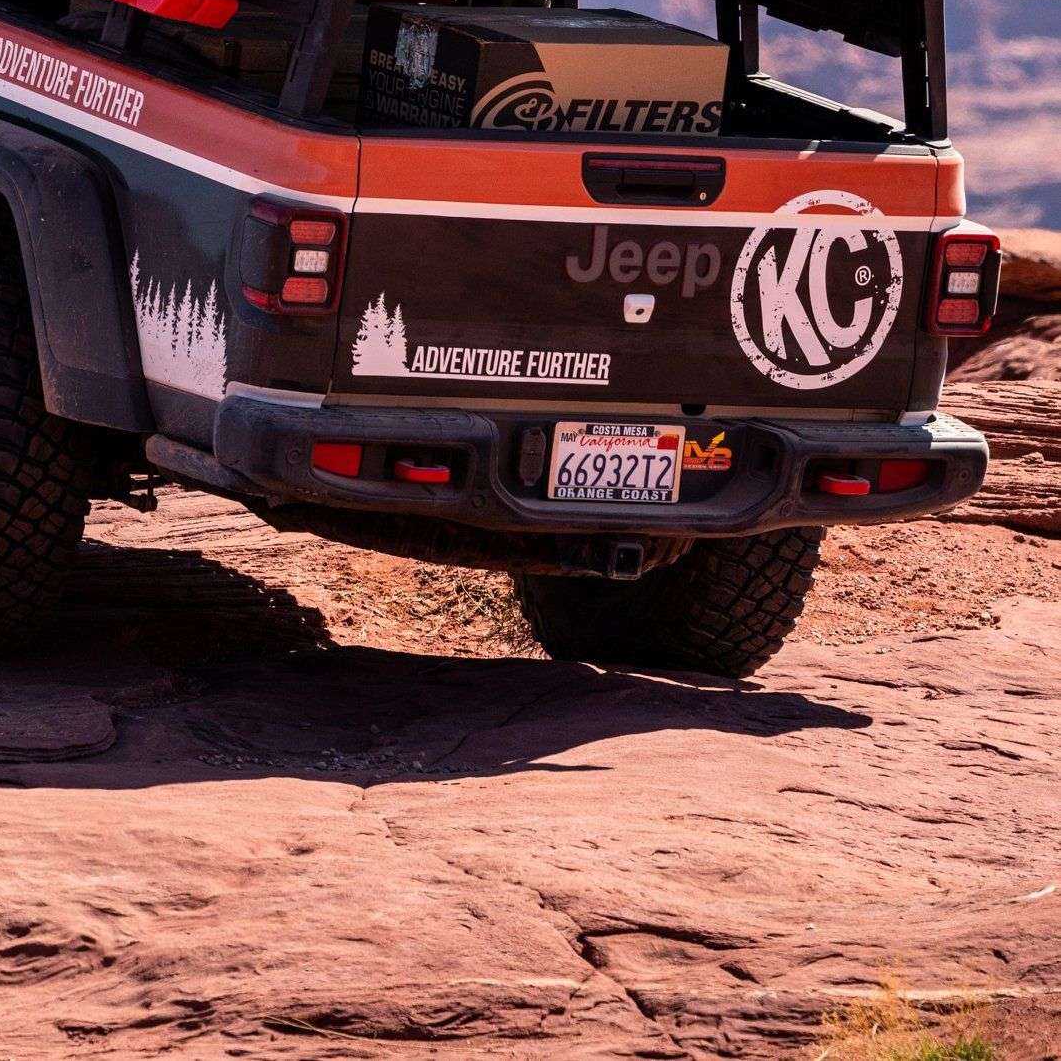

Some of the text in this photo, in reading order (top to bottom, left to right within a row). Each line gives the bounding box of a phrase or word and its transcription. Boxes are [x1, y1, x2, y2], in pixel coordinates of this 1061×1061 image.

[74, 70, 144, 126] FURTHER
[377, 92, 461, 127] WARRANTY
[561, 98, 723, 133] FILTERS
[565, 225, 720, 298] Jeep
[411, 345, 611, 379] ADVENTURE FURTHER
[561, 432, 577, 442] MAY
[579, 436, 651, 451] California
[592, 425, 647, 436] COSTA MESA
[557, 453, 672, 489] 66932T2
[557, 487, 668, 501] ORANGE COAST
